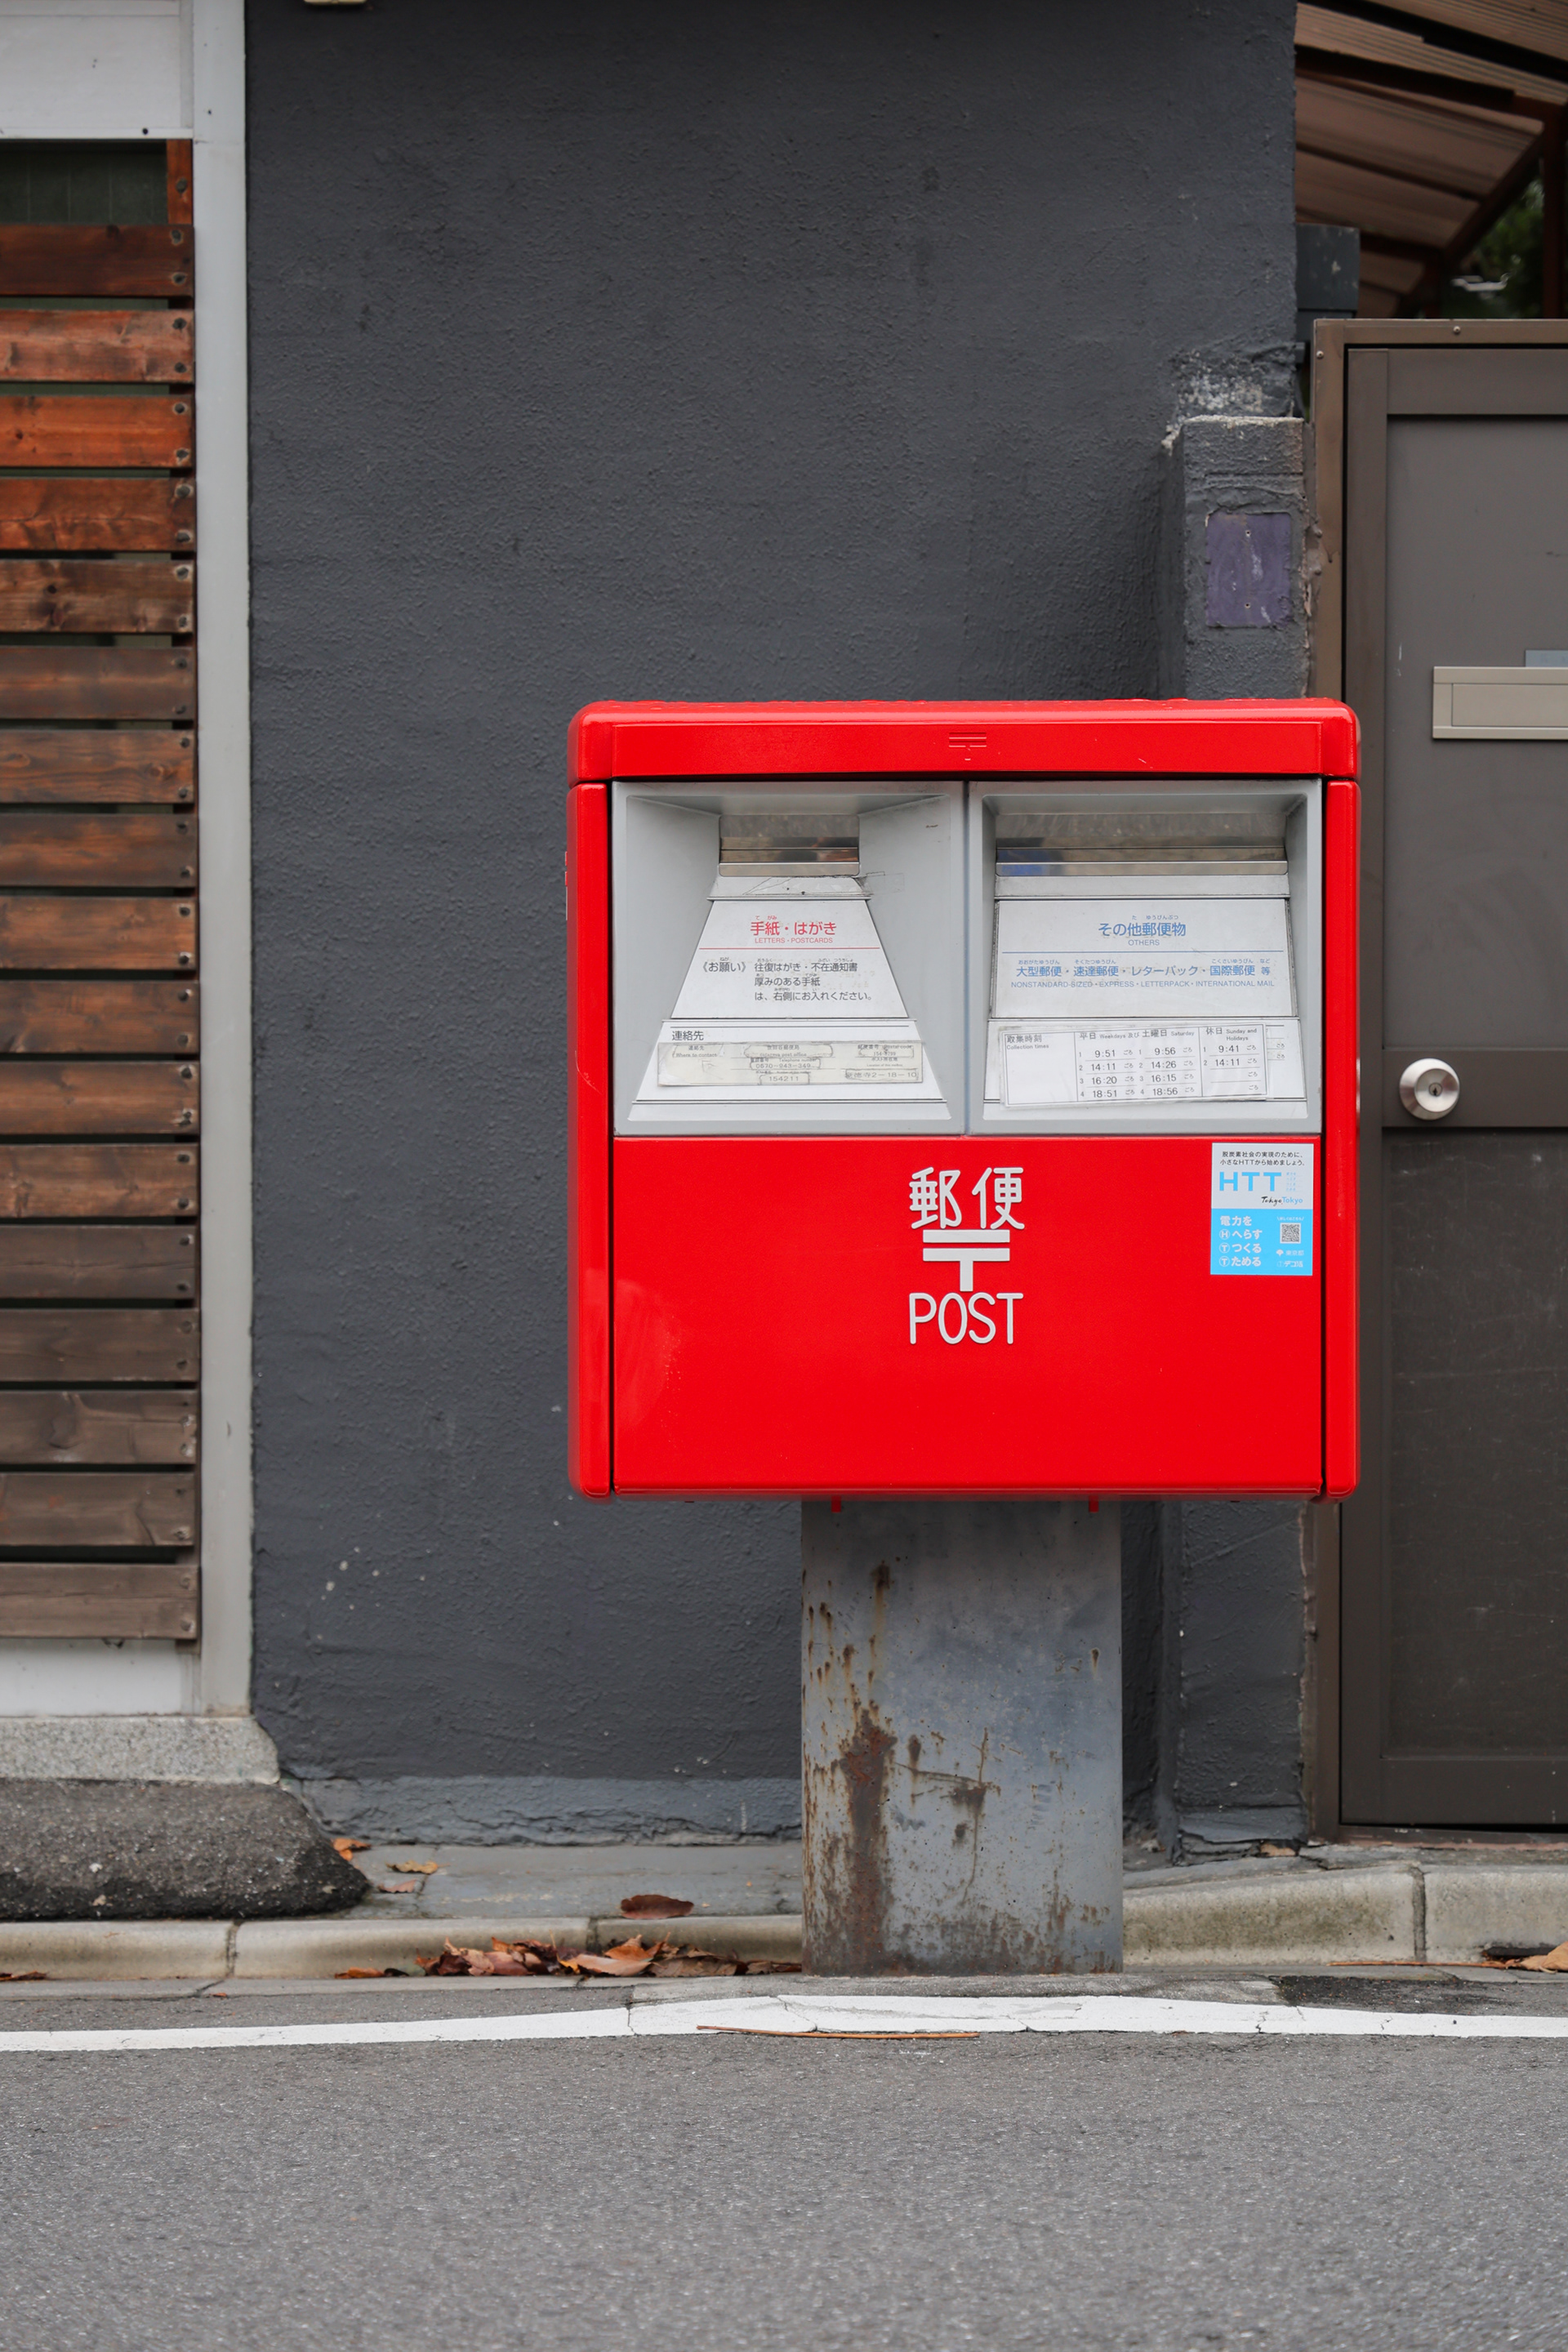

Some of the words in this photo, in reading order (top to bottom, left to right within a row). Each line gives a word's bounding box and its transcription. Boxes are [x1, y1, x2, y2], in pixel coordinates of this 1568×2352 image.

[750, 921, 837, 936] 手紙・はがき
[1098, 922, 1186, 937] その他郵便物
[754, 962, 858, 972] 往復はがき・不在通知書
[1261, 967, 1270, 976] 等
[755, 977, 820, 987] 厚みのある手紙
[755, 991, 872, 1001] は、右側にお入れください。
[1142, 1029, 1167, 1038] 土曜日
[1206, 1027, 1223, 1035] 休日
[672, 1031, 704, 1041] 連絡先
[1007, 1034, 1042, 1043] 取集時刻
[1080, 1032, 1096, 1040] 平日
[1095, 1049, 1116, 1058] 9:51
[1154, 1047, 1176, 1055] 9:56
[1218, 1045, 1240, 1053] 9:41
[1091, 1063, 1116, 1071] 14:11
[1151, 1060, 1176, 1069] 14:26
[1215, 1058, 1240, 1067] 14:11
[1091, 1076, 1117, 1085] 16:20
[1151, 1074, 1176, 1082] 16:15
[1093, 1089, 1117, 1098] 18:51
[1153, 1087, 1178, 1096] 18:56
[1219, 1172, 1282, 1192] HTT
[909, 1167, 1025, 1229] 郵便
[1220, 1216, 1252, 1226] 電力を
[909, 1292, 1024, 1345] POST
